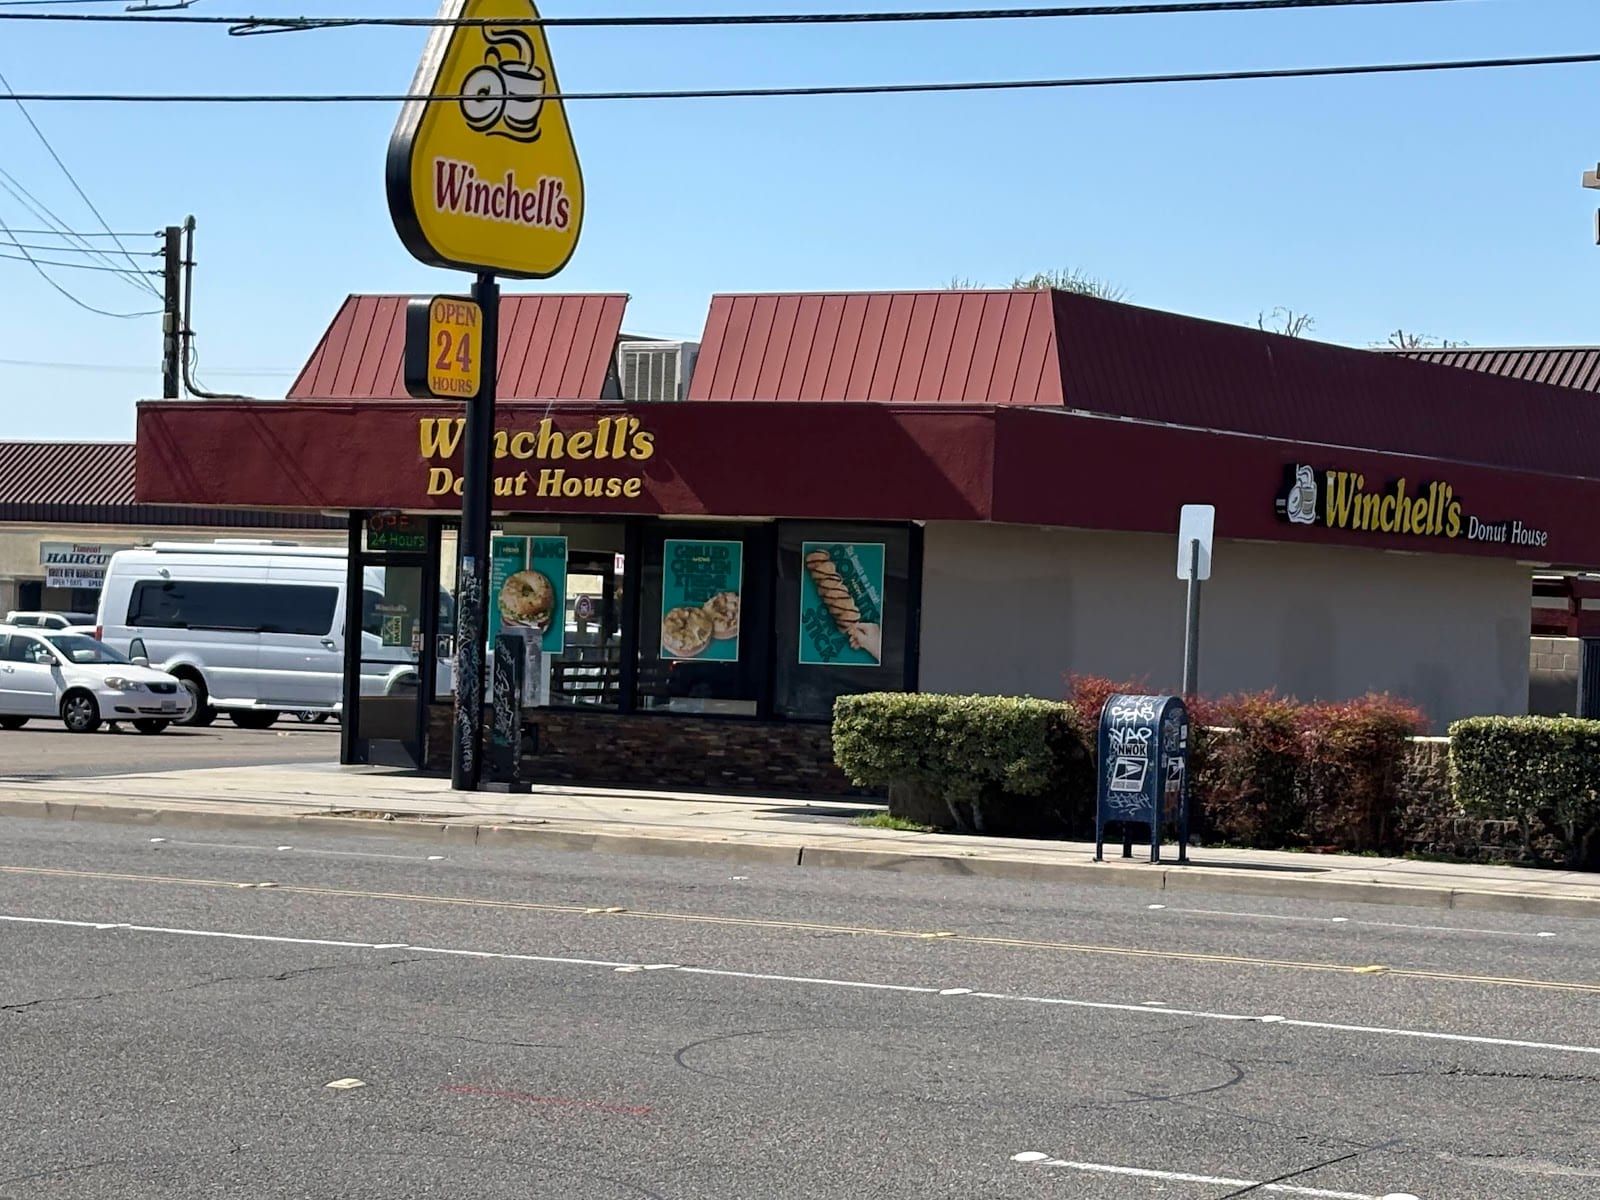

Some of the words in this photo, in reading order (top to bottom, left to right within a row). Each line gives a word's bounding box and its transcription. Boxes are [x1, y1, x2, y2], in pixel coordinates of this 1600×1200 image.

[435, 159, 570, 229] Winchell's
[434, 303, 477, 326] OPEN
[436, 330, 472, 373] 24
[433, 376, 473, 393] HOURS
[419, 416, 655, 461] Wnchell's
[426, 467, 529, 497] Dout
[537, 469, 642, 498] House
[1325, 470, 1463, 538] Winchell's
[1468, 516, 1507, 543] Donut
[1511, 521, 1548, 547] House
[1118, 744, 1146, 755] NWOK
